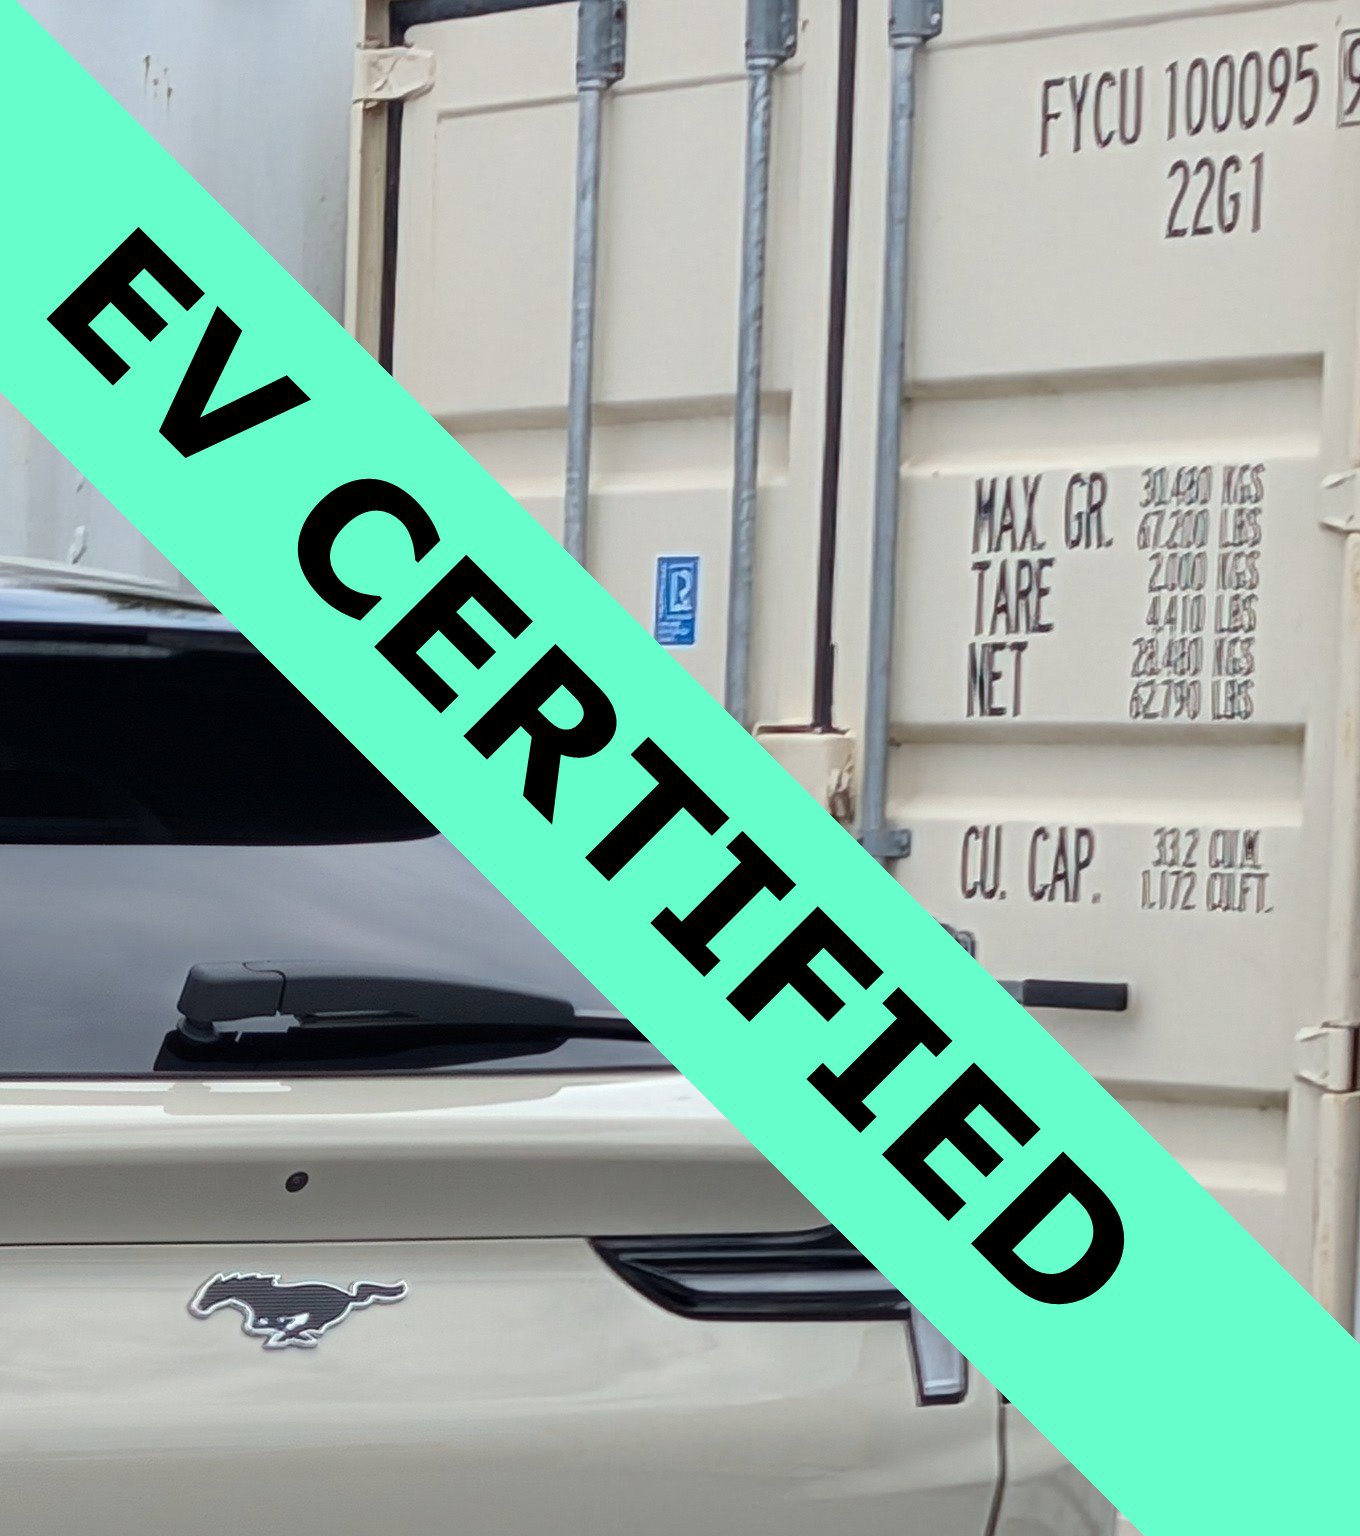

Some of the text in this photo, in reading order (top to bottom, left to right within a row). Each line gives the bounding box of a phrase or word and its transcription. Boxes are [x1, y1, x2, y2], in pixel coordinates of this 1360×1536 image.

[1039, 66, 1144, 157] FYCU
[1165, 43, 1319, 140] 100095
[1165, 150, 1265, 239] 22G1
[1065, 471, 1114, 550] GR.
[971, 557, 1055, 636] TARE
[967, 641, 1028, 718] NET
[960, 824, 1007, 900] CU.
[1028, 825, 1102, 904] CAP.
